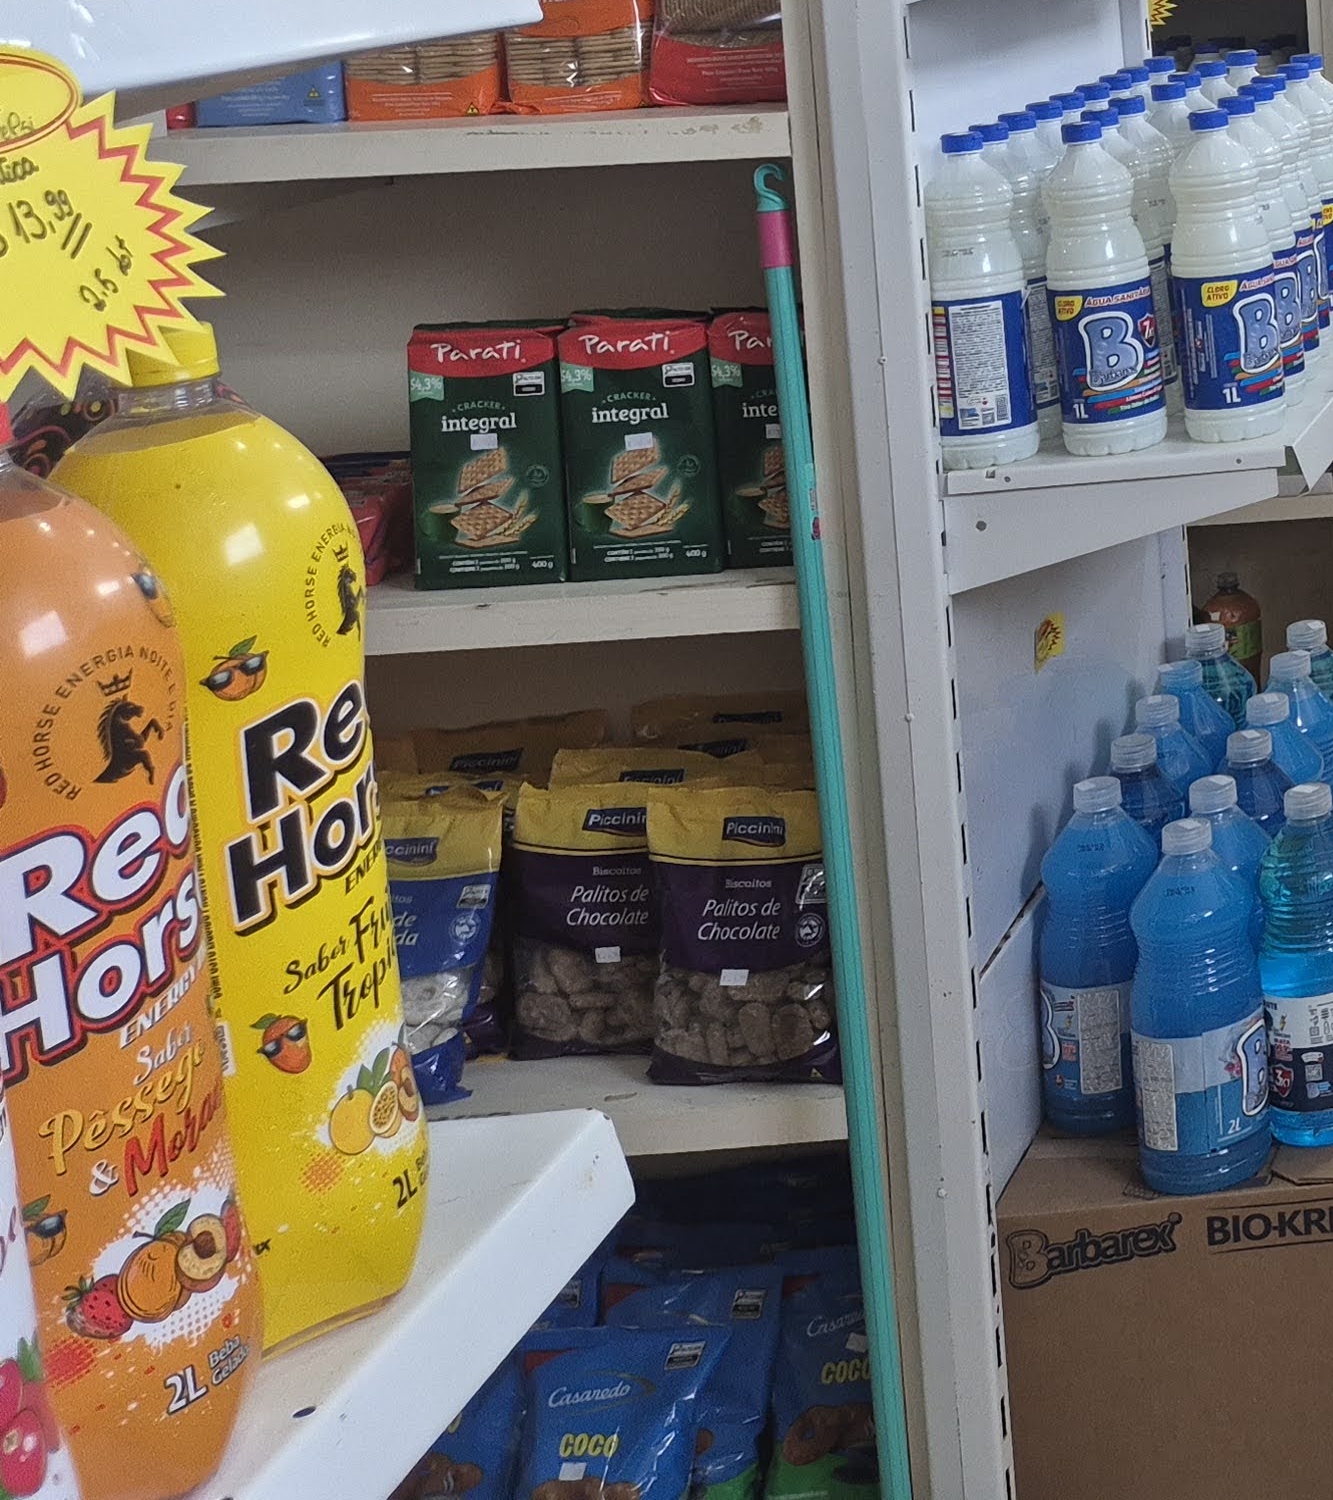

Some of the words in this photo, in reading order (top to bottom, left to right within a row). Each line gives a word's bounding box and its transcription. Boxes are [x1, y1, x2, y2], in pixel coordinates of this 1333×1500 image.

[431, 339, 522, 364] Parati
[579, 330, 671, 355] Parati
[1222, 386, 1242, 404] 1L
[441, 414, 518, 434] integral
[592, 402, 670, 426] integral
[1072, 402, 1089, 420] 1L
[305, 565, 319, 619] HORSE
[56, 645, 136, 705] ENERGIA
[35, 710, 58, 773] HORSE
[54, 771, 82, 801] RED
[725, 821, 784, 837] Piccinini
[570, 885, 631, 904] Palitos
[631, 885, 649, 902] de
[566, 906, 649, 927] Chocolate
[702, 899, 762, 918] Palitos
[765, 899, 782, 916] de
[697, 921, 780, 942] Chocolate
[284, 936, 349, 995] Sabor
[88, 1158, 119, 1198] &
[391, 1168, 419, 1210] 2L
[1007, 1219, 1176, 1289] Barbarex
[209, 1336, 242, 1368] Beba
[164, 1364, 209, 1416] 2L
[548, 1381, 631, 1408] Casaredo
[559, 1432, 620, 1458] COCO
